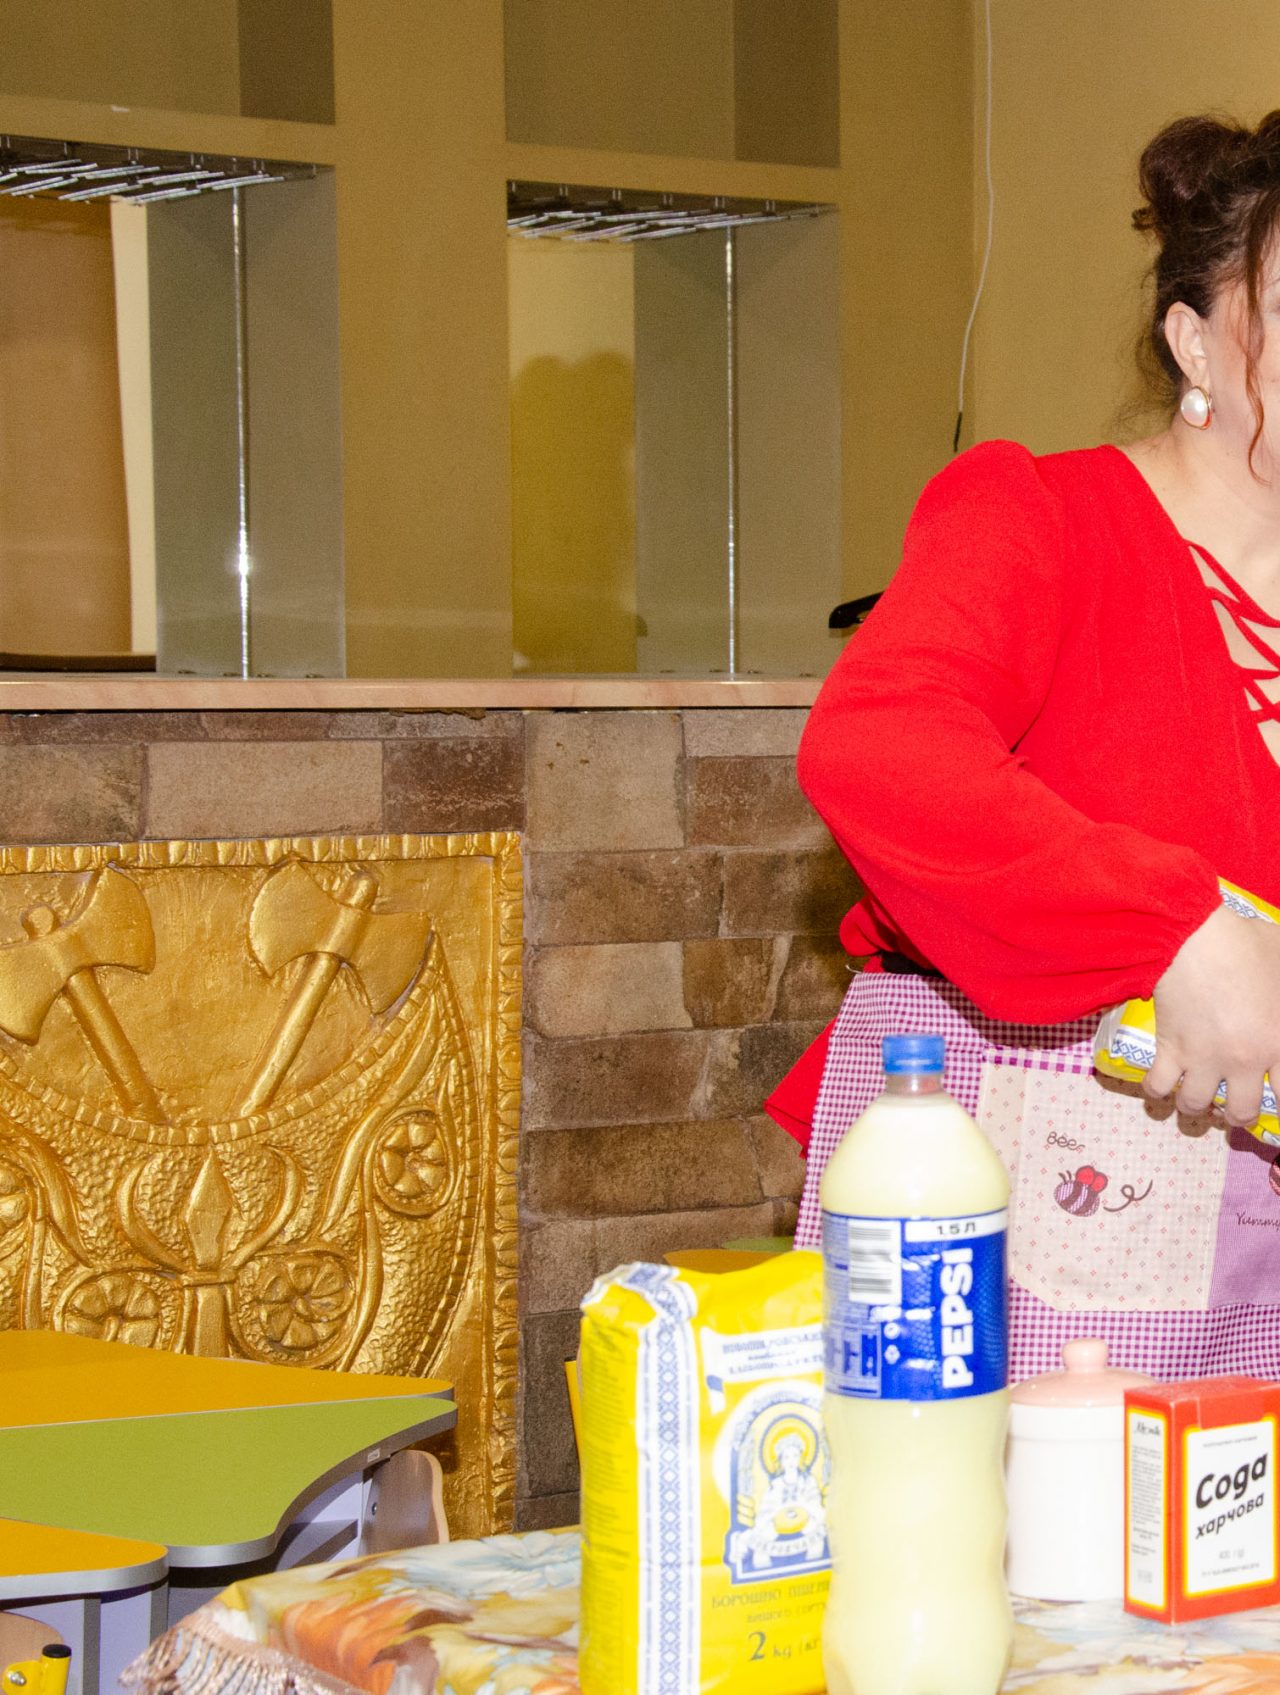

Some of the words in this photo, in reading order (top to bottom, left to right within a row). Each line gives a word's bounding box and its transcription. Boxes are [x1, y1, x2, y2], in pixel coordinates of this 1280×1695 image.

[1236, 1210, 1280, 1231] Yummy
[940, 1248, 974, 1389] PEPSI
[1195, 1453, 1268, 1509] Сода
[1195, 1493, 1265, 1540] харчова
[747, 1631, 766, 1662] 2
